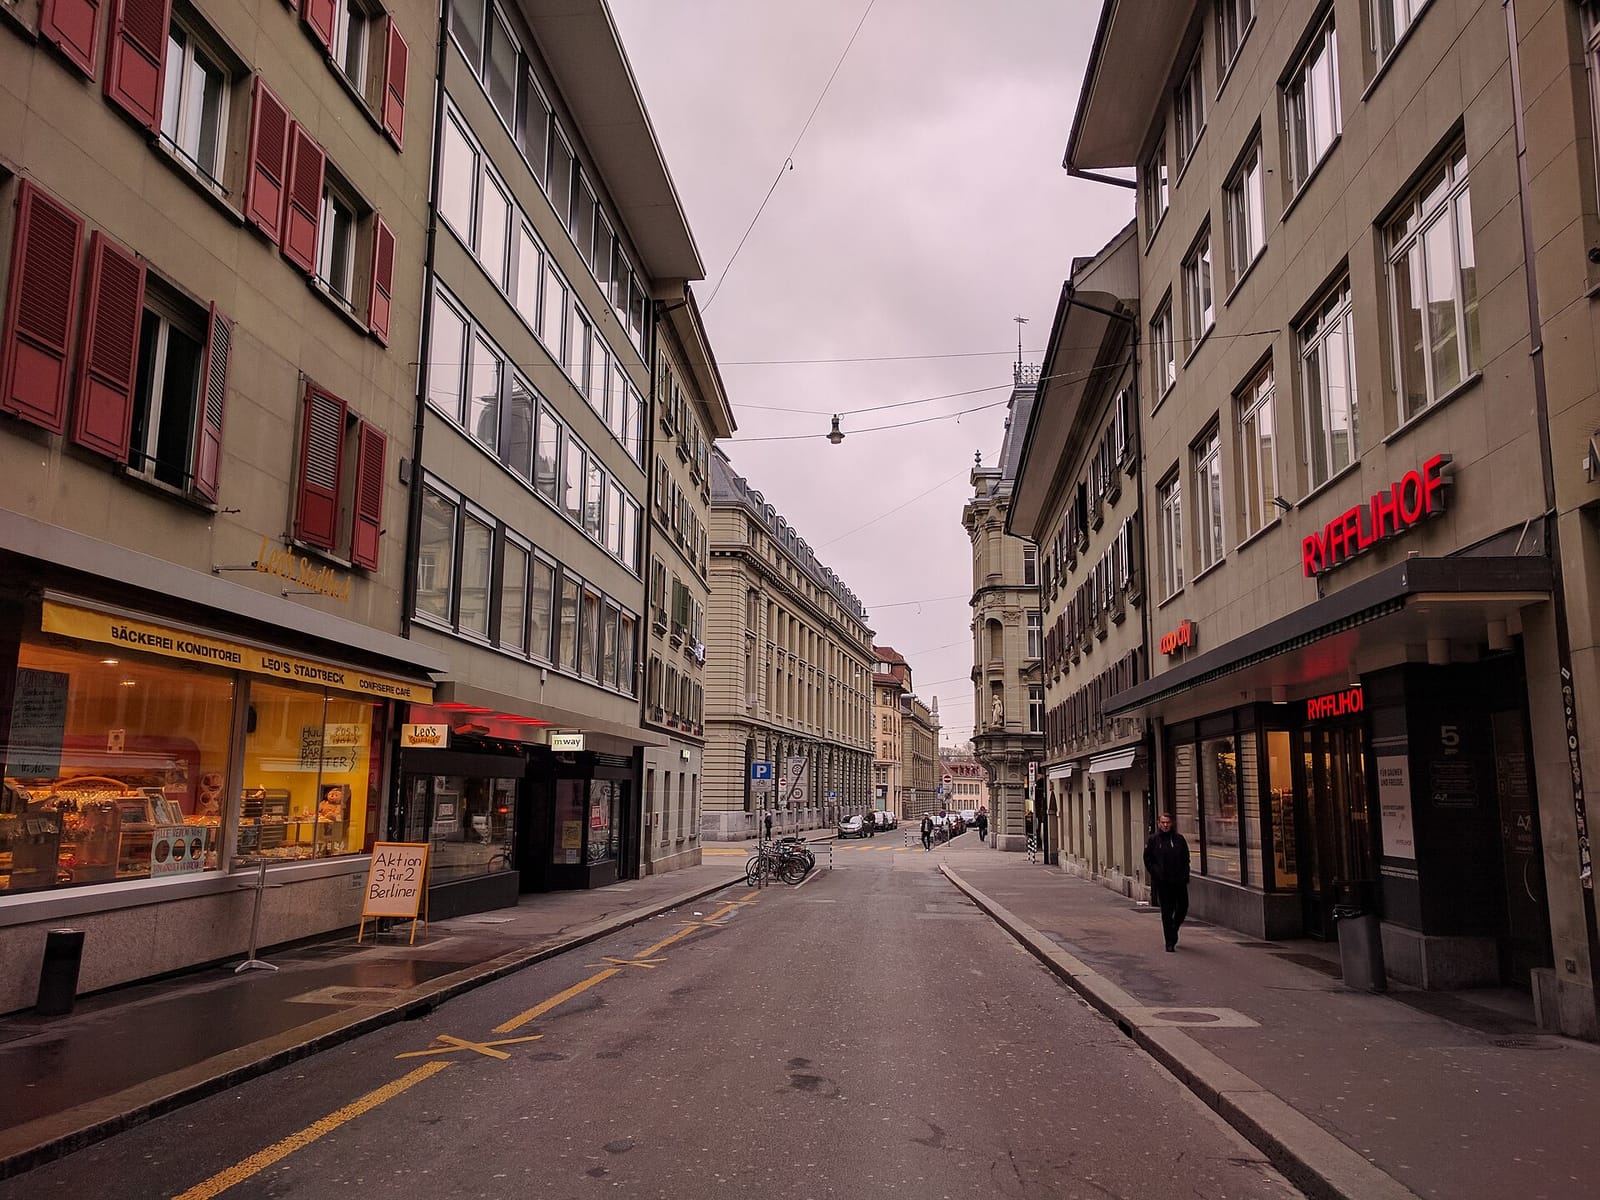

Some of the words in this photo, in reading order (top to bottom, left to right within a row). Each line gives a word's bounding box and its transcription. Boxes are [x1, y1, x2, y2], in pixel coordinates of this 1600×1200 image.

[1302, 453, 1442, 578] RYFFLIHOF
[111, 626, 173, 650] BÄCKEREI
[176, 640, 242, 664] KONDITOREI
[261, 656, 291, 674] LEO'S
[293, 663, 345, 685] STADTBECK
[414, 725, 437, 737] Leo's
[1440, 725, 1461, 746] 5
[554, 738, 580, 748] mway
[756, 765, 767, 778] P
[374, 852, 422, 867] Aktion
[375, 869, 386, 882] 3
[403, 867, 415, 881] 2
[369, 883, 417, 899] Berliner
